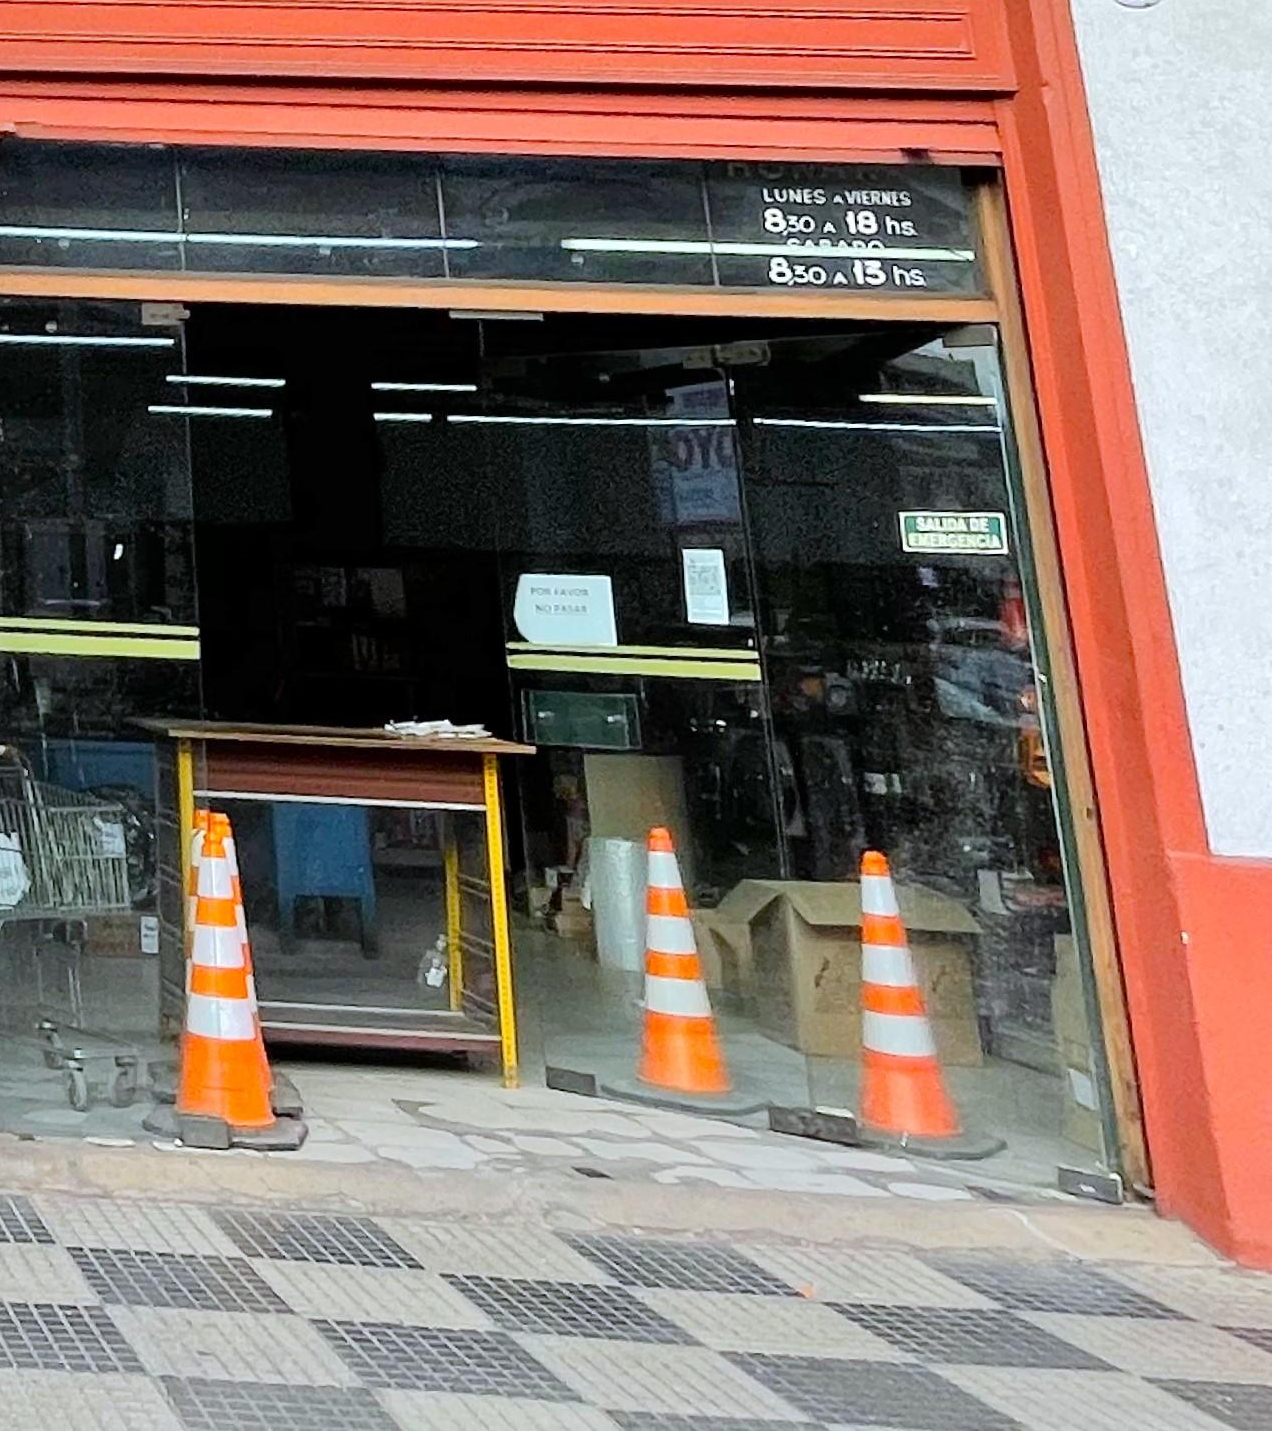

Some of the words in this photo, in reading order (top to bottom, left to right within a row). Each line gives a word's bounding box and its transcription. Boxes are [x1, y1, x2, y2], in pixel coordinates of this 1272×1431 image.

[761, 188, 827, 206] LUNES
[844, 190, 913, 207] VIERNES
[763, 207, 816, 235] 8,30
[823, 221, 837, 234] A
[845, 210, 880, 236] 18
[768, 257, 828, 286] 8,30
[833, 271, 849, 285] A
[915, 516, 968, 532] SALIDA
[970, 518, 990, 532] DE
[908, 532, 1002, 549] EMERGENCIA
